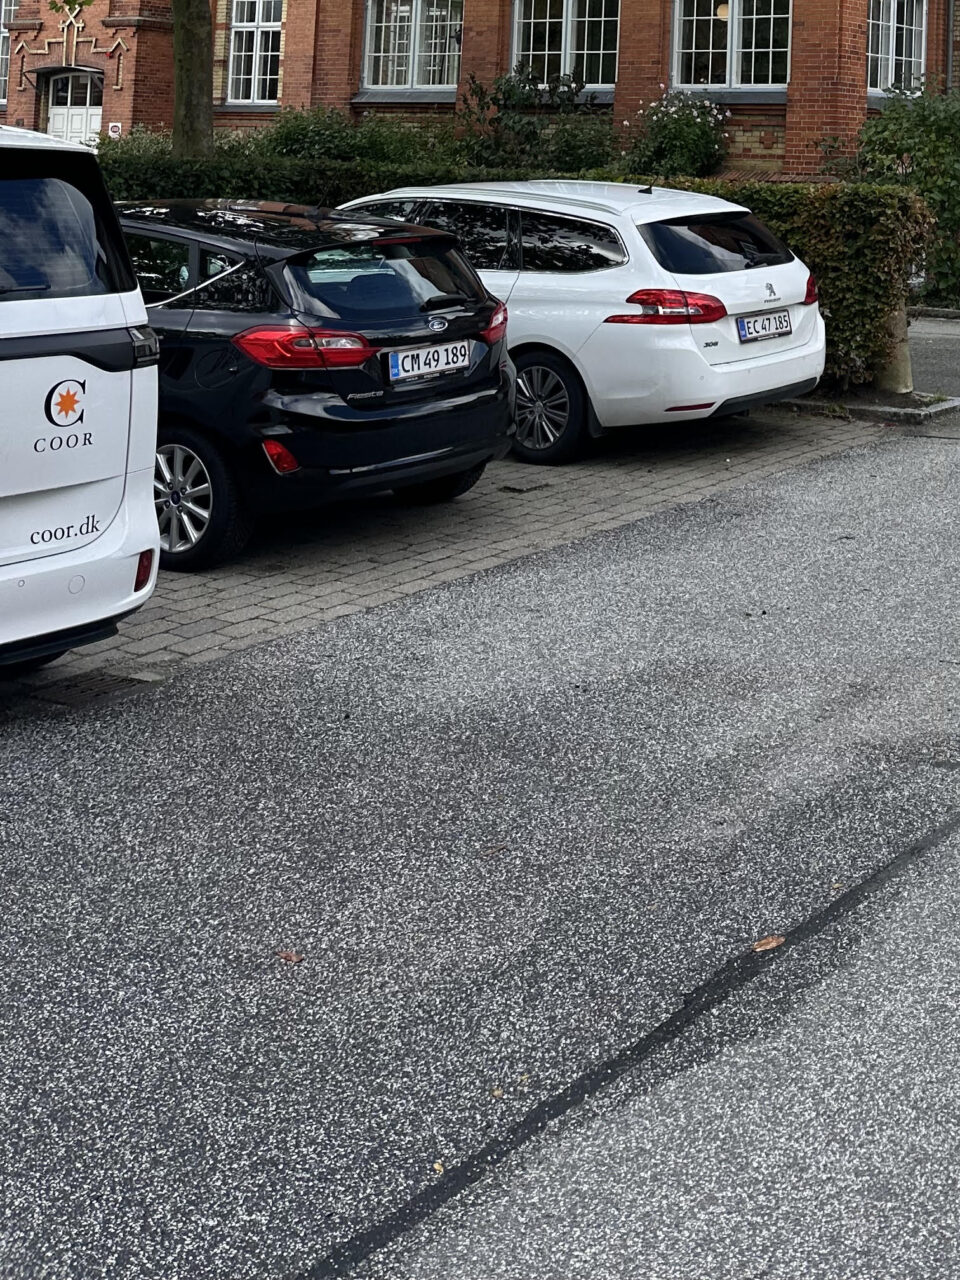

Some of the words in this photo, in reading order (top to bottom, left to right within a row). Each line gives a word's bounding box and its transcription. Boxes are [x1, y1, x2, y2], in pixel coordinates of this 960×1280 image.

[746, 319, 760, 335] EC
[761, 318, 771, 332] 47
[774, 315, 789, 330] 185
[401, 353, 420, 373] CM
[423, 350, 440, 368] 49
[444, 345, 467, 365] 189
[33, 432, 93, 452] COOR
[30, 514, 100, 544] coor.dk
